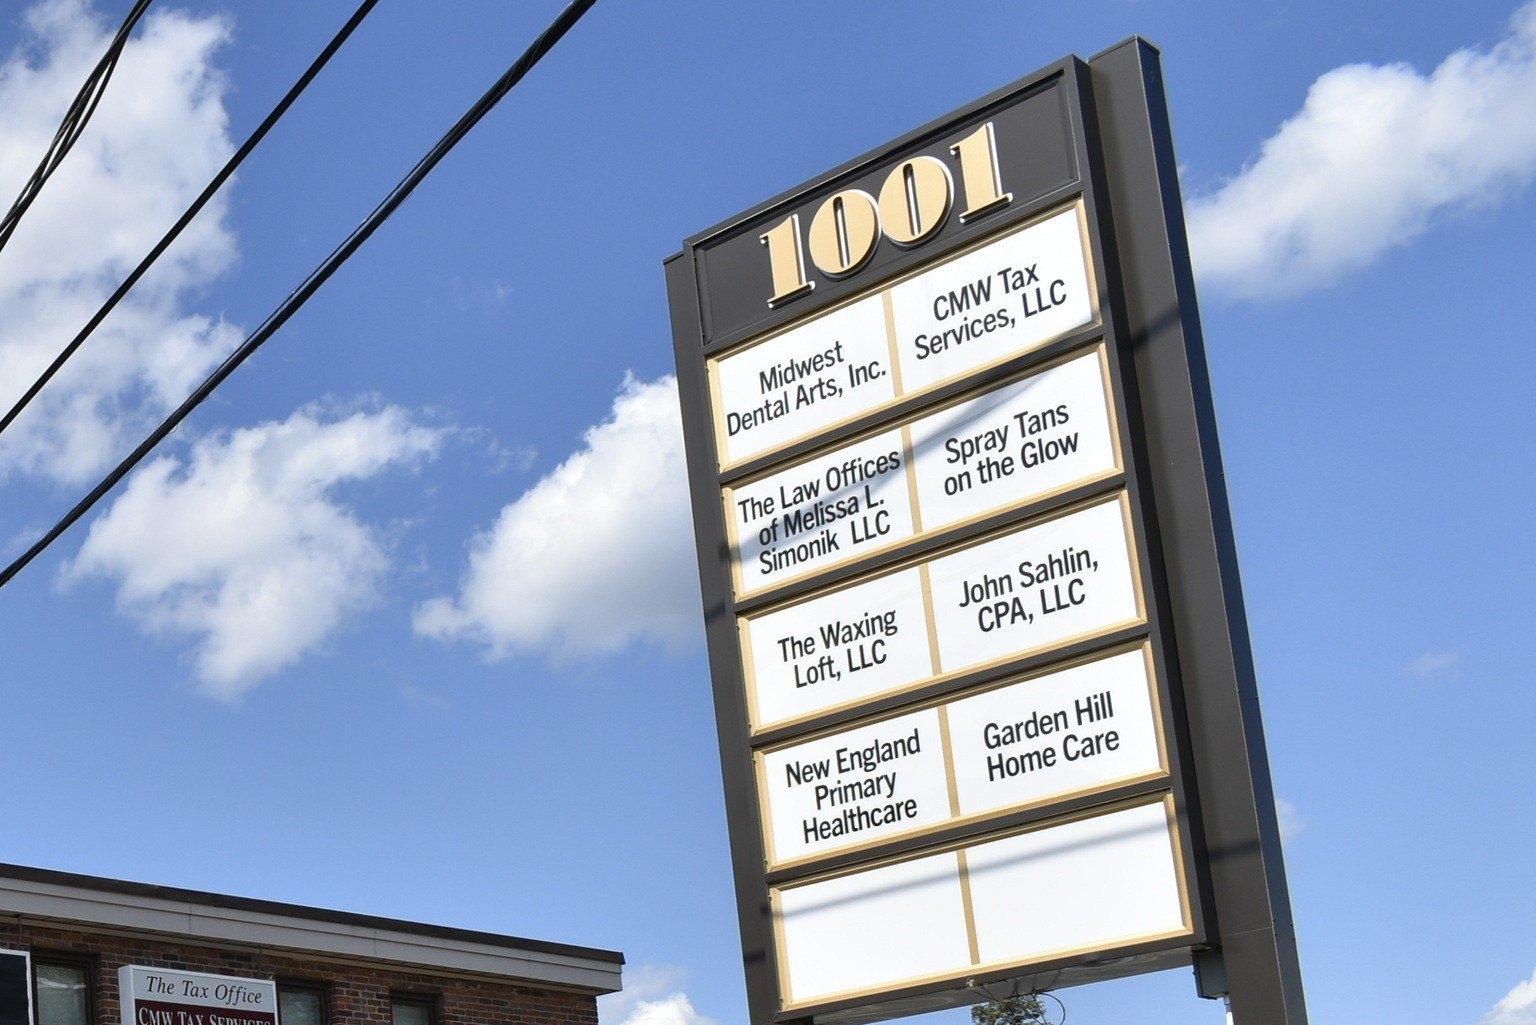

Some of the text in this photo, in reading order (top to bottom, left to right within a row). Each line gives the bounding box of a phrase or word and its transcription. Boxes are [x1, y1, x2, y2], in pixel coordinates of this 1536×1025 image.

[759, 121, 1013, 309] 1001
[915, 279, 1068, 360] Services, LLC
[933, 263, 1040, 322] CMW Tax
[759, 340, 844, 394] Midwest
[726, 360, 887, 437] Dental Arts, Inc.
[944, 404, 1070, 465] Spray Tans
[738, 450, 901, 524] The Law Offices
[944, 433, 1080, 497] on the Glow
[758, 484, 885, 546] of Melissa L.
[759, 510, 891, 575] Simonik LLC
[959, 546, 1100, 608] John Sahlin,
[978, 579, 1086, 633] CPA, LLC
[778, 609, 898, 663] The Waxing
[794, 639, 887, 689] Loft, LLC
[983, 690, 1114, 750] Garden Hill
[785, 728, 921, 788] New England
[986, 729, 1120, 782] Home Care
[814, 770, 897, 811] Primary
[802, 798, 918, 845] Healthcare
[146, 976, 262, 1006] The Tax Office
